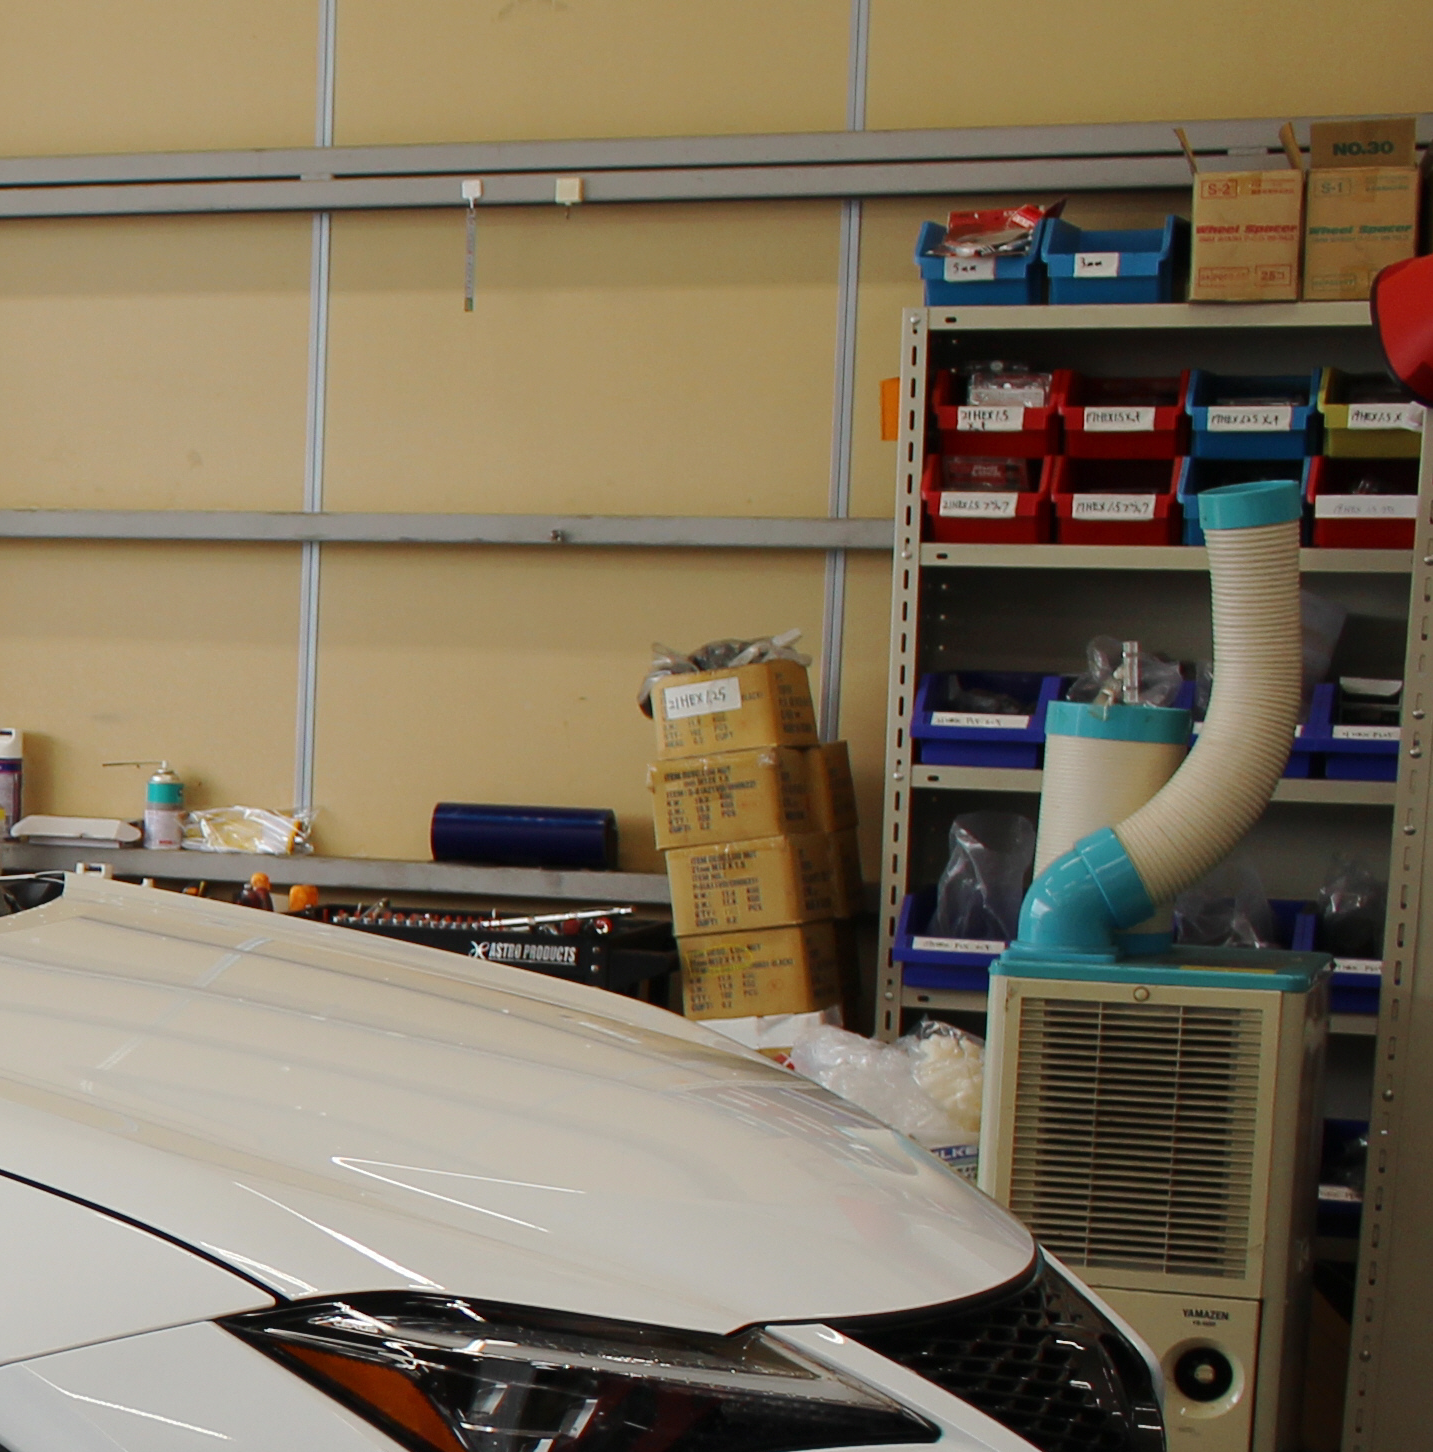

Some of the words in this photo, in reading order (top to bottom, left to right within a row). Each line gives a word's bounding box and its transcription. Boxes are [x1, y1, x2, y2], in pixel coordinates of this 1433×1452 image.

[1333, 141, 1394, 156] NO.30
[1208, 183, 1231, 196] S-2
[488, 941, 522, 959] ASTRO
[523, 943, 577, 963] PRODUCTS
[1182, 1308, 1229, 1320] YAMAZEN
